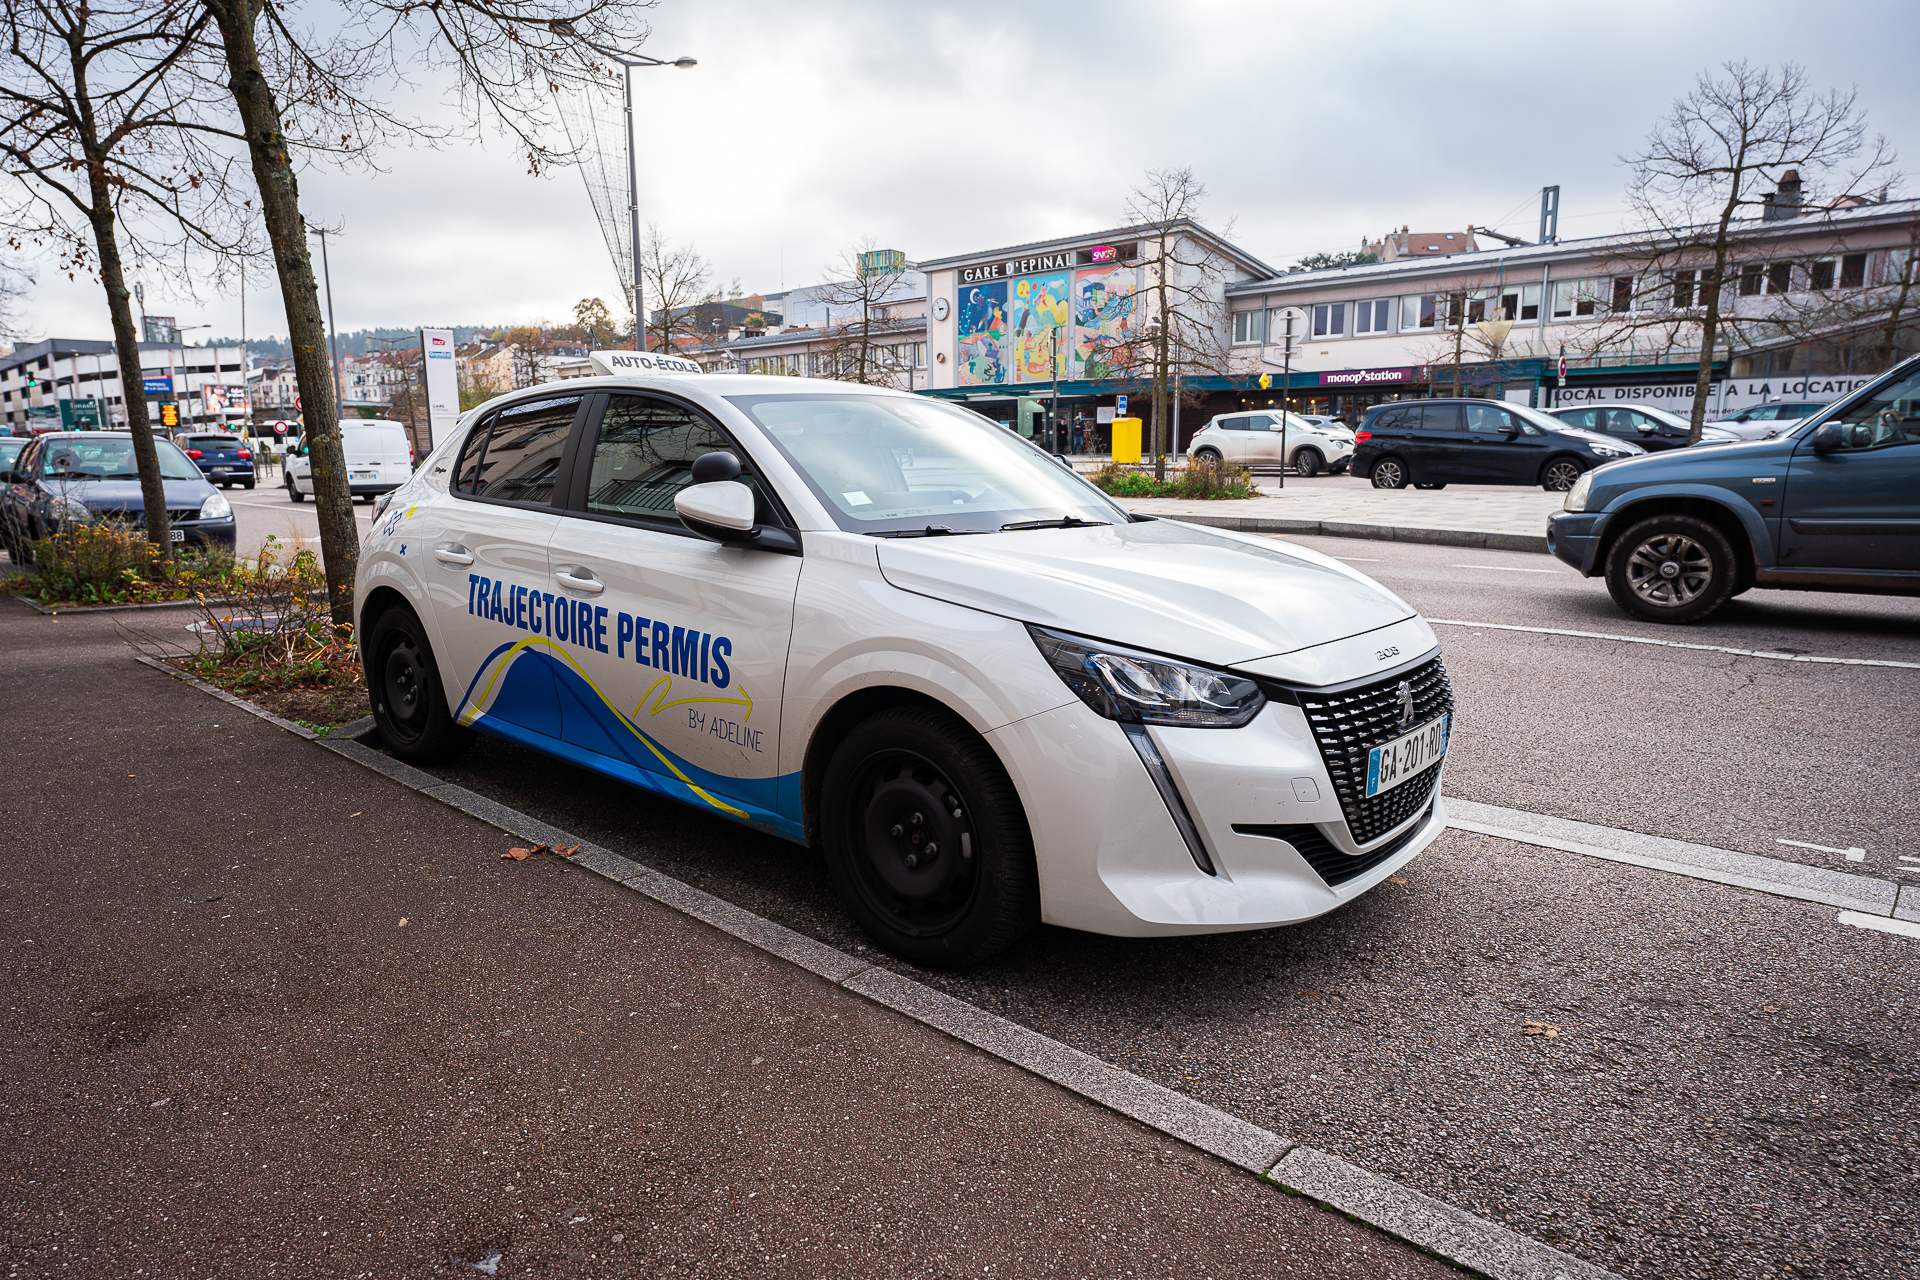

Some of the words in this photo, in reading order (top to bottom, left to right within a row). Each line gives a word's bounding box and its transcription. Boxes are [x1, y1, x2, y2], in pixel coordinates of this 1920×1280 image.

[1092, 248, 1117, 261] SNCF
[964, 264, 999, 282] GARE
[1005, 253, 1072, 275] D'EPINAL
[611, 355, 701, 374] AUTO-ÉCOLE
[1554, 389, 1606, 402] LOCAL
[1614, 385, 1717, 400] DISPONIBE
[1725, 384, 1738, 396] A
[1748, 383, 1771, 396] LA
[169, 531, 183, 540] 88
[468, 573, 609, 654] TRAJECTOIRE
[616, 611, 733, 689] PERMIS
[1374, 646, 1401, 661] 208
[688, 708, 705, 731] BY
[709, 716, 764, 753] ADELINE
[1380, 721, 1441, 784] GA-201-RD
